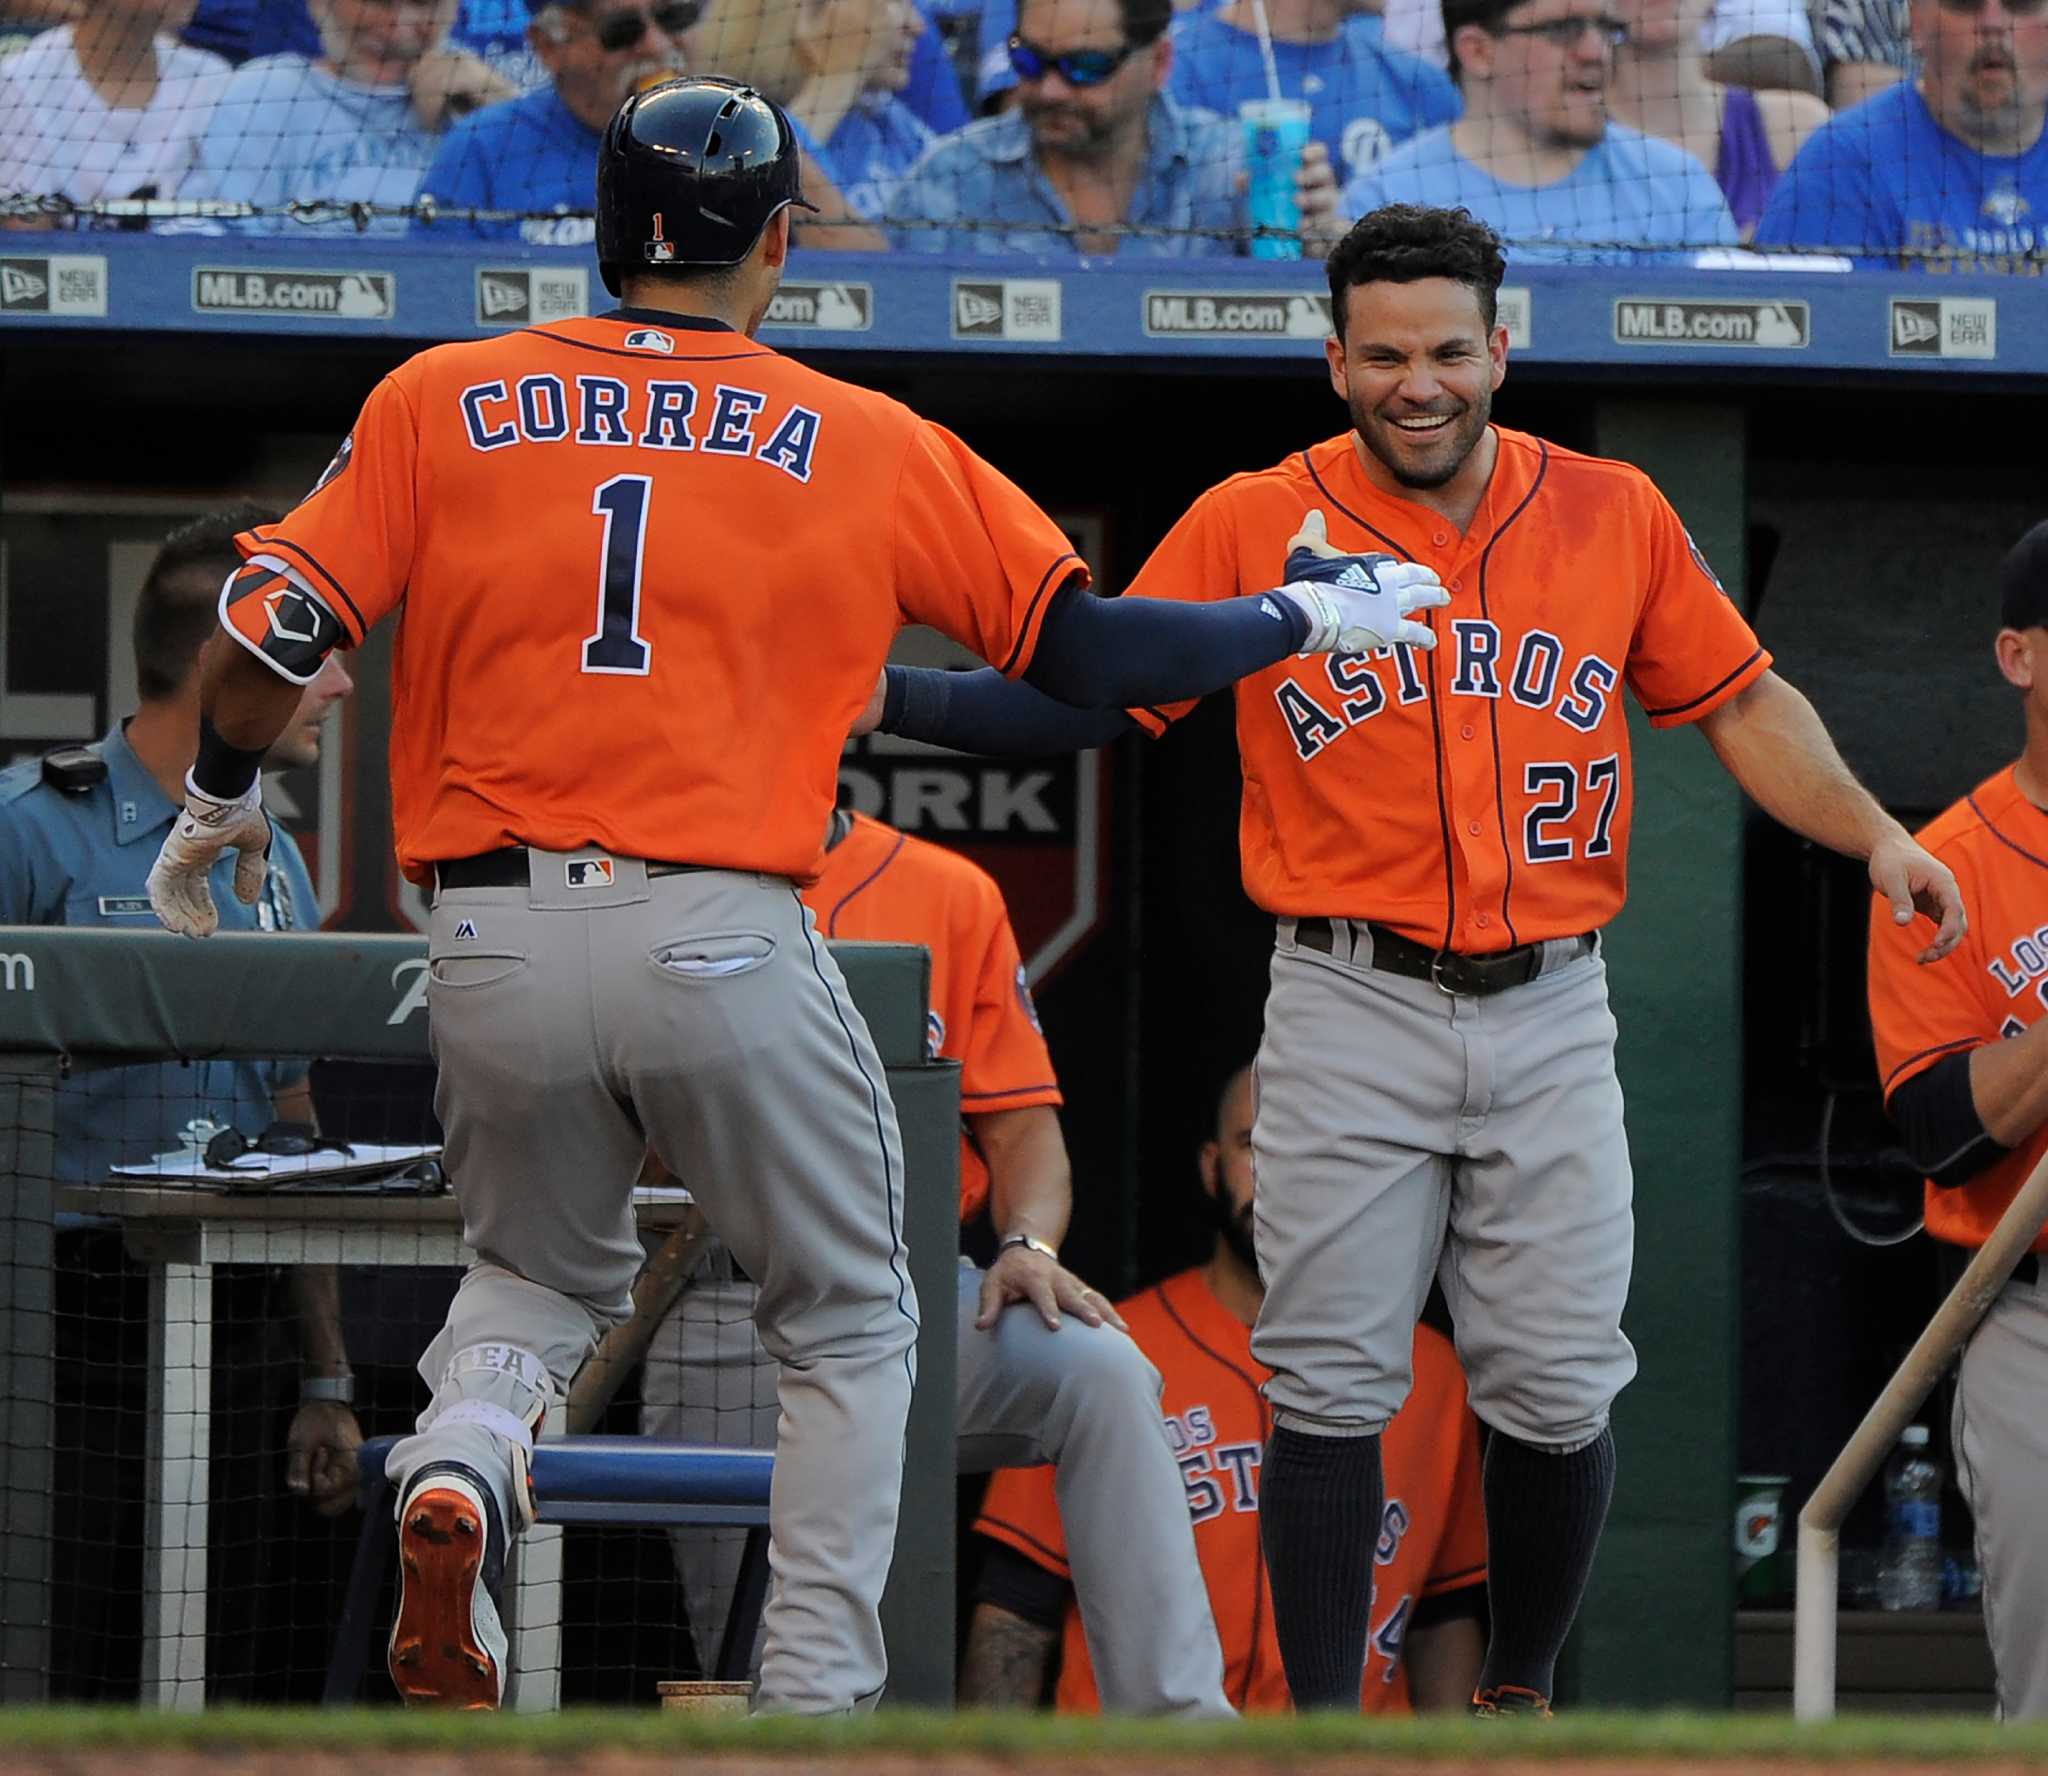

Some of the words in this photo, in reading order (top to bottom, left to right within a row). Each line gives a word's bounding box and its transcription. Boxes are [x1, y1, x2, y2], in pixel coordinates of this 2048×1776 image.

[652, 212, 664, 241] 1
[200, 273, 337, 309] MLB.com
[1150, 298, 1284, 331] MLB.com
[1621, 305, 1752, 339] MLB.com
[1950, 314, 1988, 329] NEW
[1950, 330, 1988, 345] ERA
[459, 373, 822, 484] CORREA
[581, 473, 653, 675] 1
[1274, 618, 1618, 762] ASTROS
[1523, 752, 1620, 864] 27
